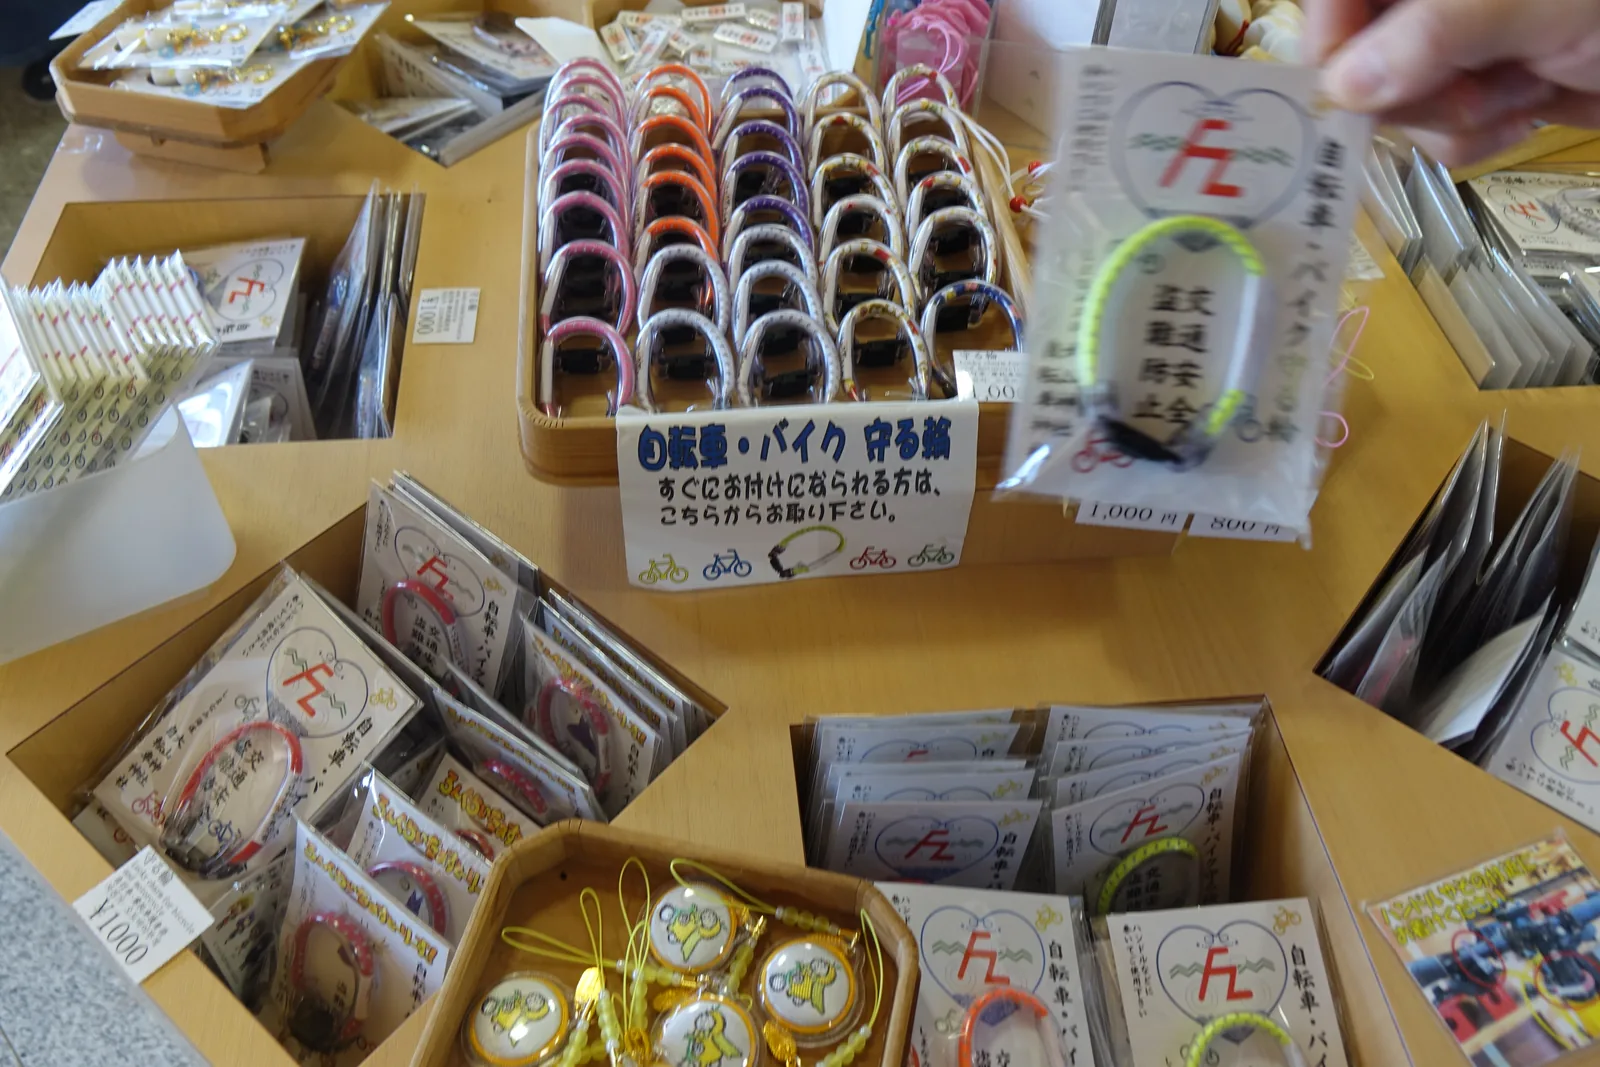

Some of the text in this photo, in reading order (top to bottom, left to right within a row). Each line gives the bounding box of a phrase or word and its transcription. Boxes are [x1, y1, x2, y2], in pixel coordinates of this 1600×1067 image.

[638, 415, 952, 472] 自転車・バイク 守る輪
[658, 467, 941, 501] すぐにお付けになられる方は、
[660, 500, 896, 527] こちらからお取り下さい。
[1089, 500, 1153, 521] 1,000
